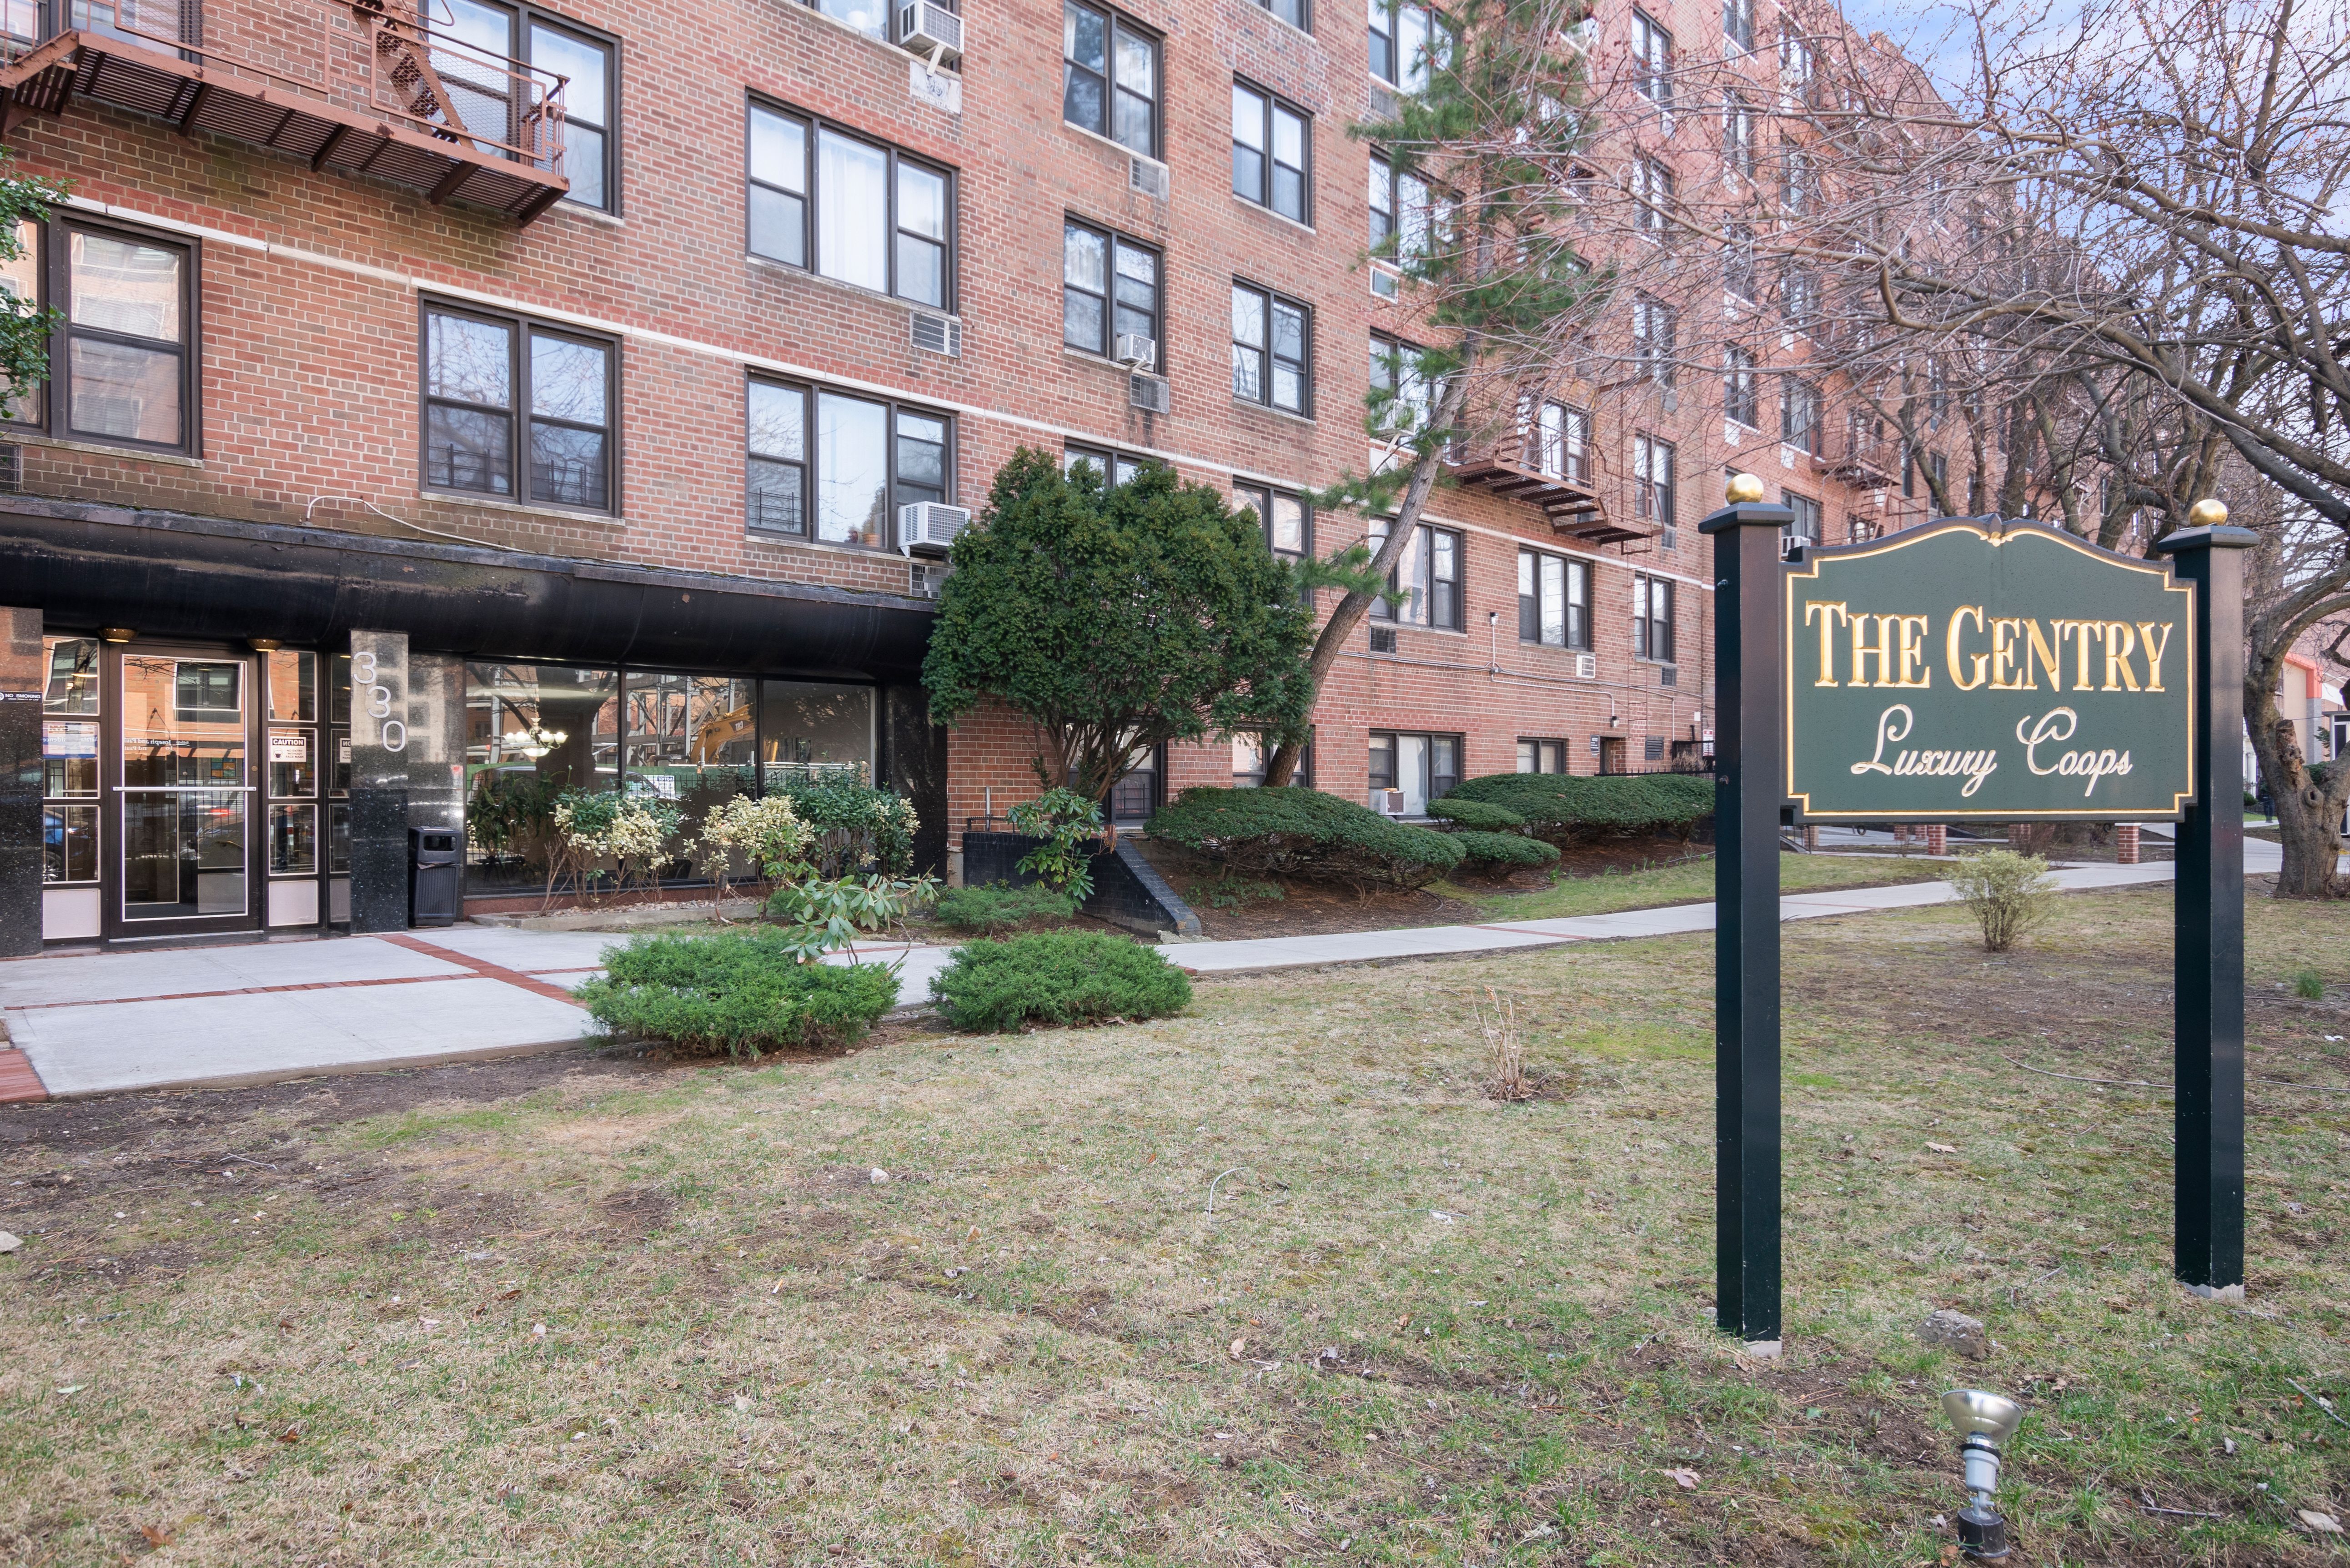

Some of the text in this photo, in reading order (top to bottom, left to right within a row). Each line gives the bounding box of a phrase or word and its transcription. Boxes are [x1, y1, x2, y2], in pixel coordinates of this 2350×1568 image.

[1805, 600, 2173, 693] THE GENTRY
[353, 651, 406, 752] 330
[1850, 703, 2134, 798] Luxury Coops
